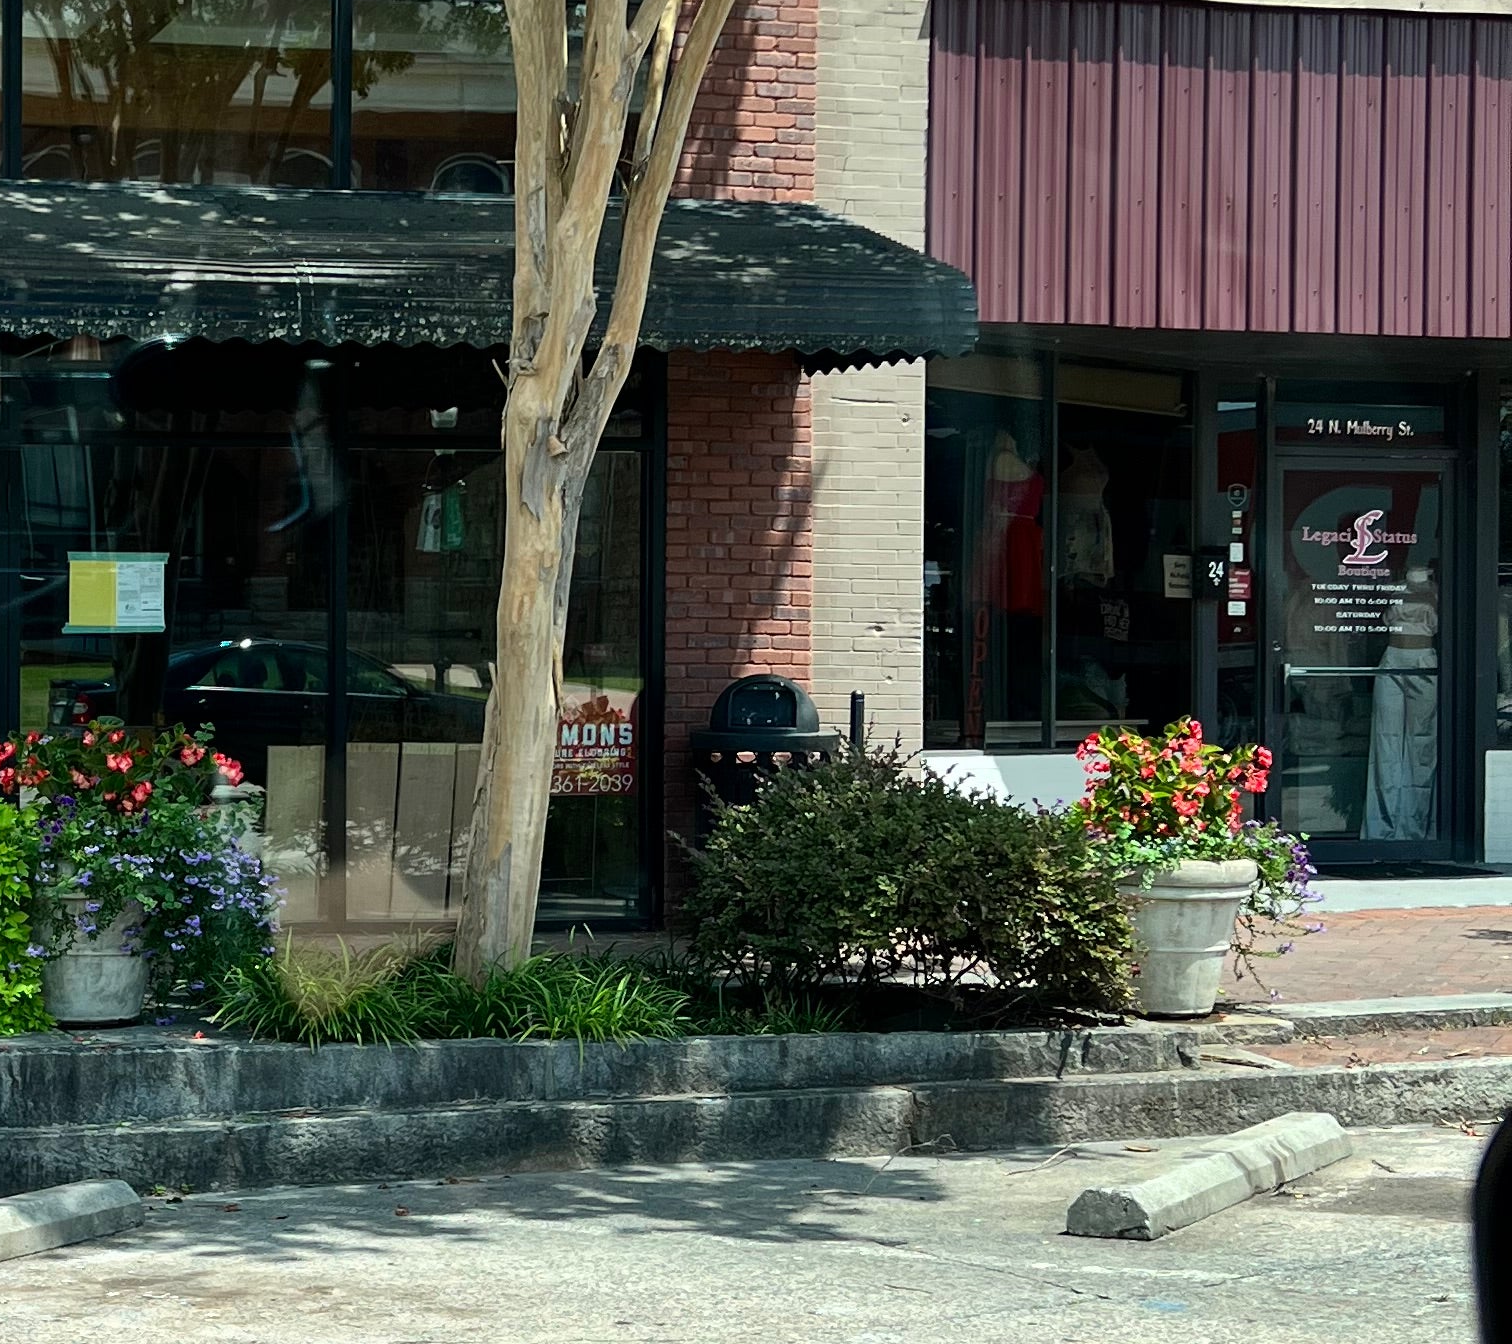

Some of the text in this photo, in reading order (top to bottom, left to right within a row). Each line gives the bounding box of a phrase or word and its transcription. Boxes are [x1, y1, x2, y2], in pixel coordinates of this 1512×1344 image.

[1307, 419, 1415, 441] 24 N. Mulberry St.
[1302, 526, 1418, 546] Legaci Status
[1208, 561, 1224, 578] 24
[1338, 565, 1391, 579] Boutique
[1376, 584, 1407, 592] FRIDAY
[1338, 597, 1353, 605] AM
[1389, 598, 1404, 606] PM
[1336, 611, 1382, 619] SATURDAY
[1338, 625, 1353, 633] AM
[1355, 625, 1366, 633] TO
[561, 723, 633, 746] MONS
[555, 748, 574, 757] URE
[550, 774, 633, 793] 361-2039
